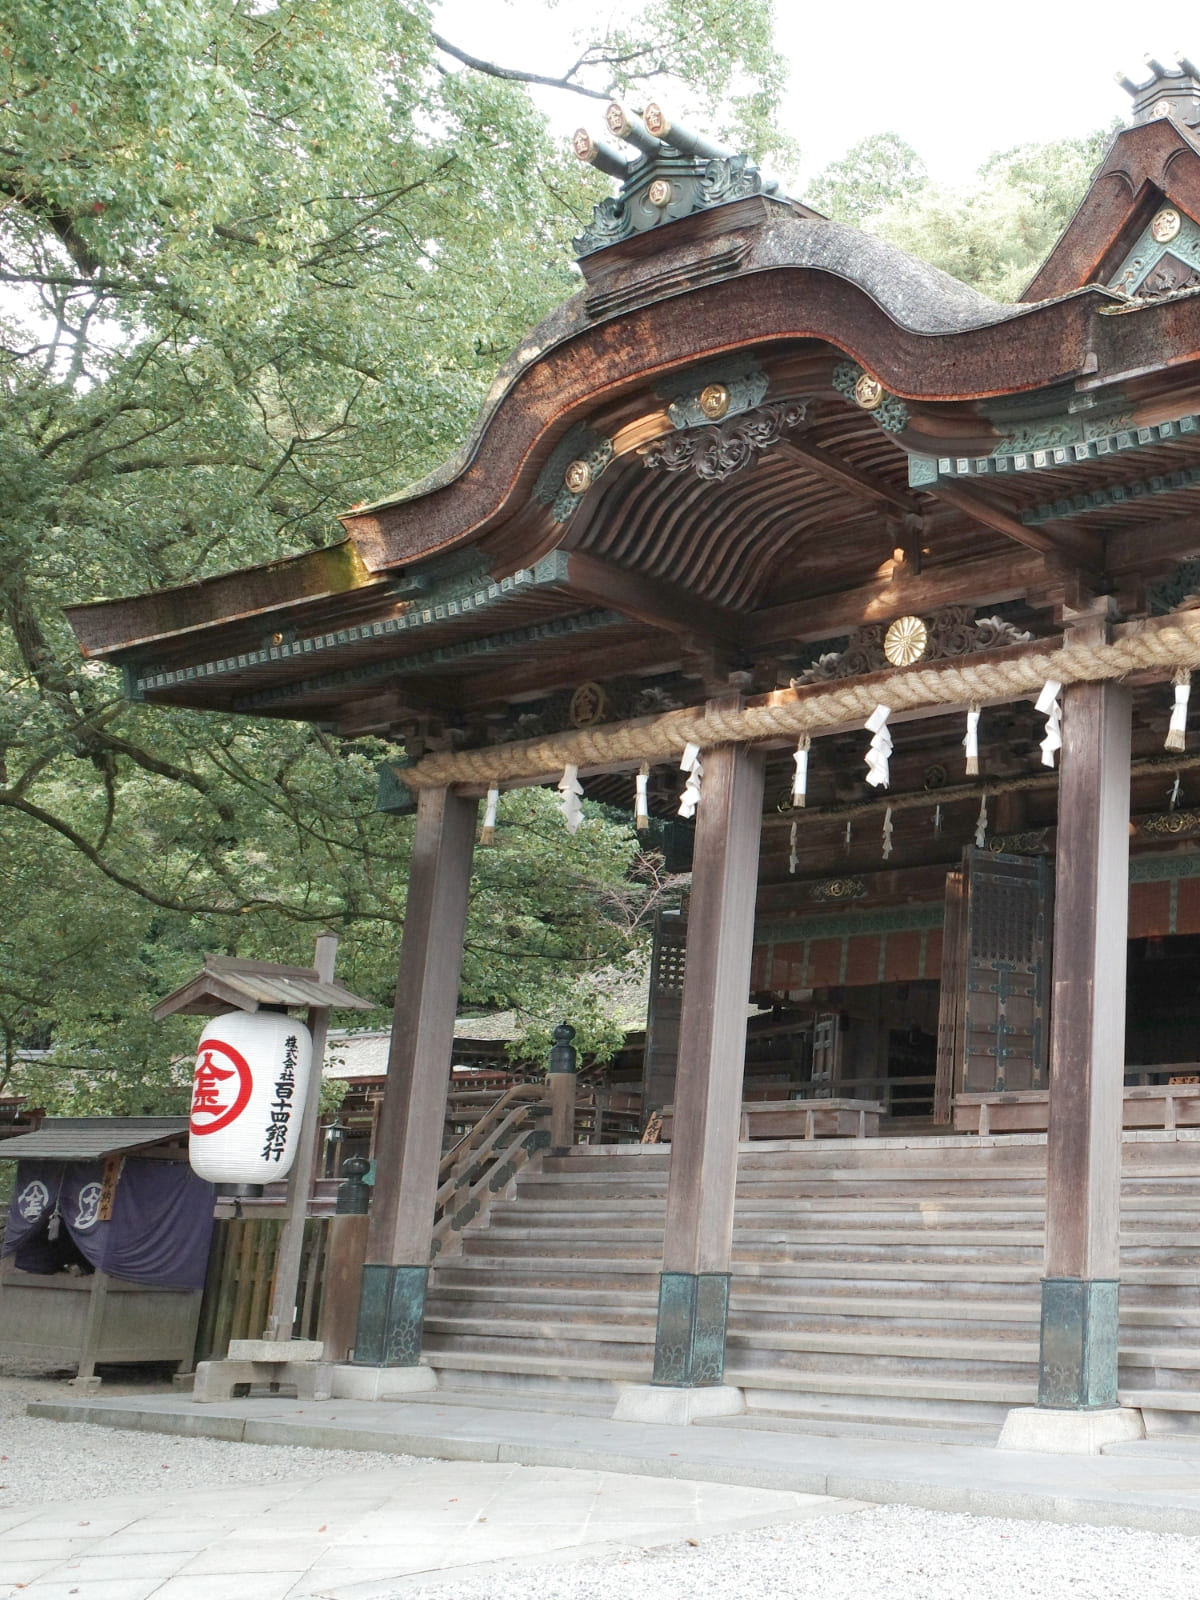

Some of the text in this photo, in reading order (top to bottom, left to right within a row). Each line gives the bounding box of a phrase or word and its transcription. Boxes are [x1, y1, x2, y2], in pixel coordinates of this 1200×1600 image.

[261, 1035, 299, 1162] 株式会社百十四銀行
